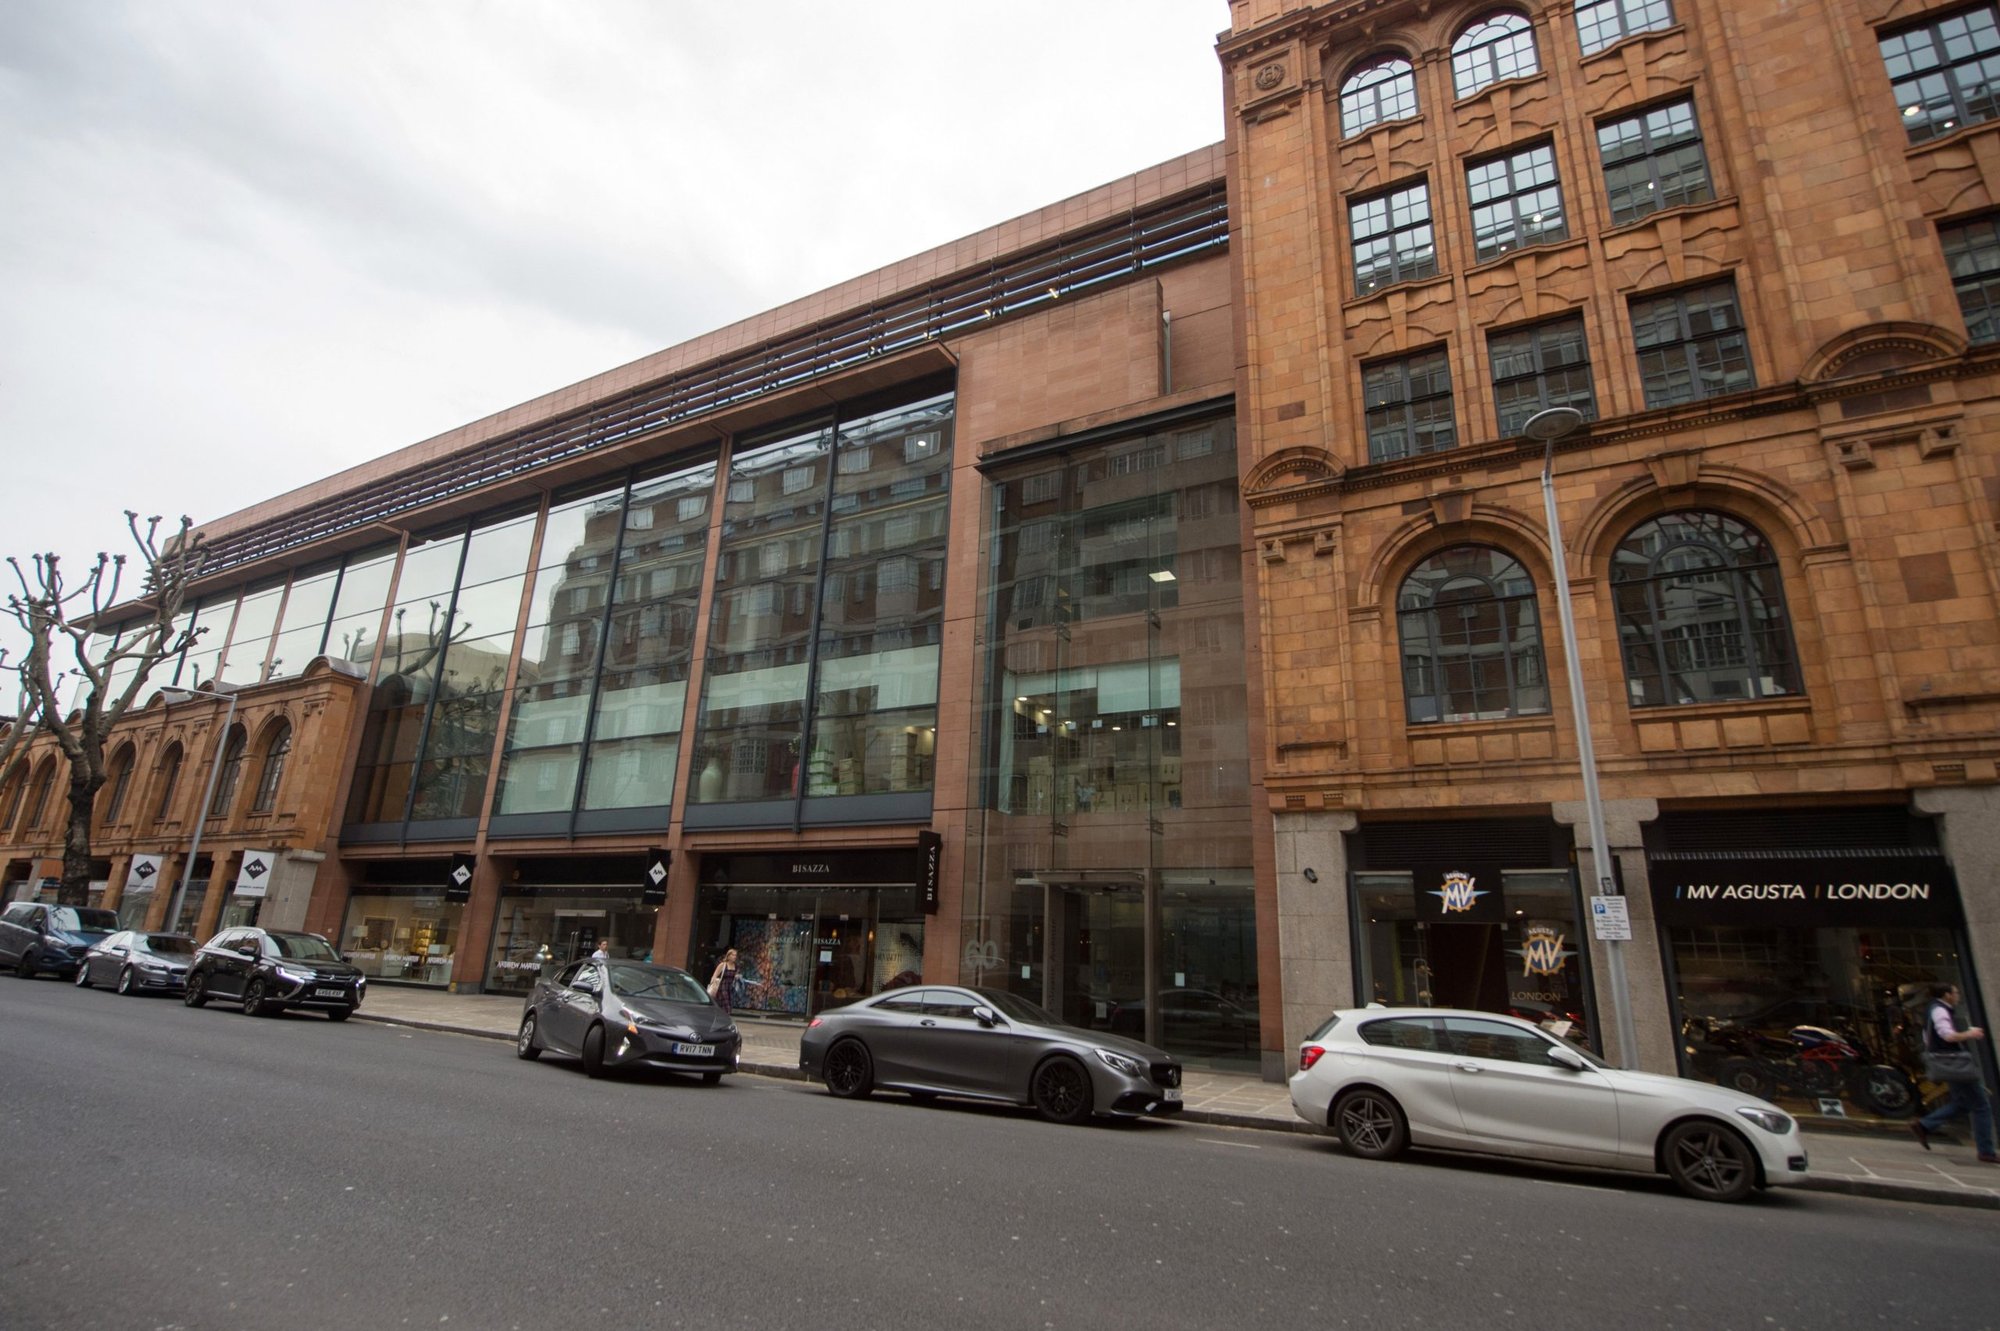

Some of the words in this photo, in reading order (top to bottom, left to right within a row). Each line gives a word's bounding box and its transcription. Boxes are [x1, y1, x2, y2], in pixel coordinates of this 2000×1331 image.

[792, 864, 830, 873] BISAZZA
[926, 846, 936, 901] BISAZZA
[1441, 877, 1476, 914] MV
[1687, 884, 1720, 899] MV
[1721, 884, 1806, 899] AGUSTA
[1827, 884, 1930, 899] LONDON
[1528, 927, 1554, 935] AGUSTA
[964, 940, 998, 969] 60
[1523, 934, 1565, 977] MV
[496, 960, 519, 969] ANDREW
[519, 962, 542, 971] MARTIN
[1511, 991, 1561, 1002] LONDON
[680, 1044, 696, 1053] RV17
[698, 1045, 712, 1054] TNN
